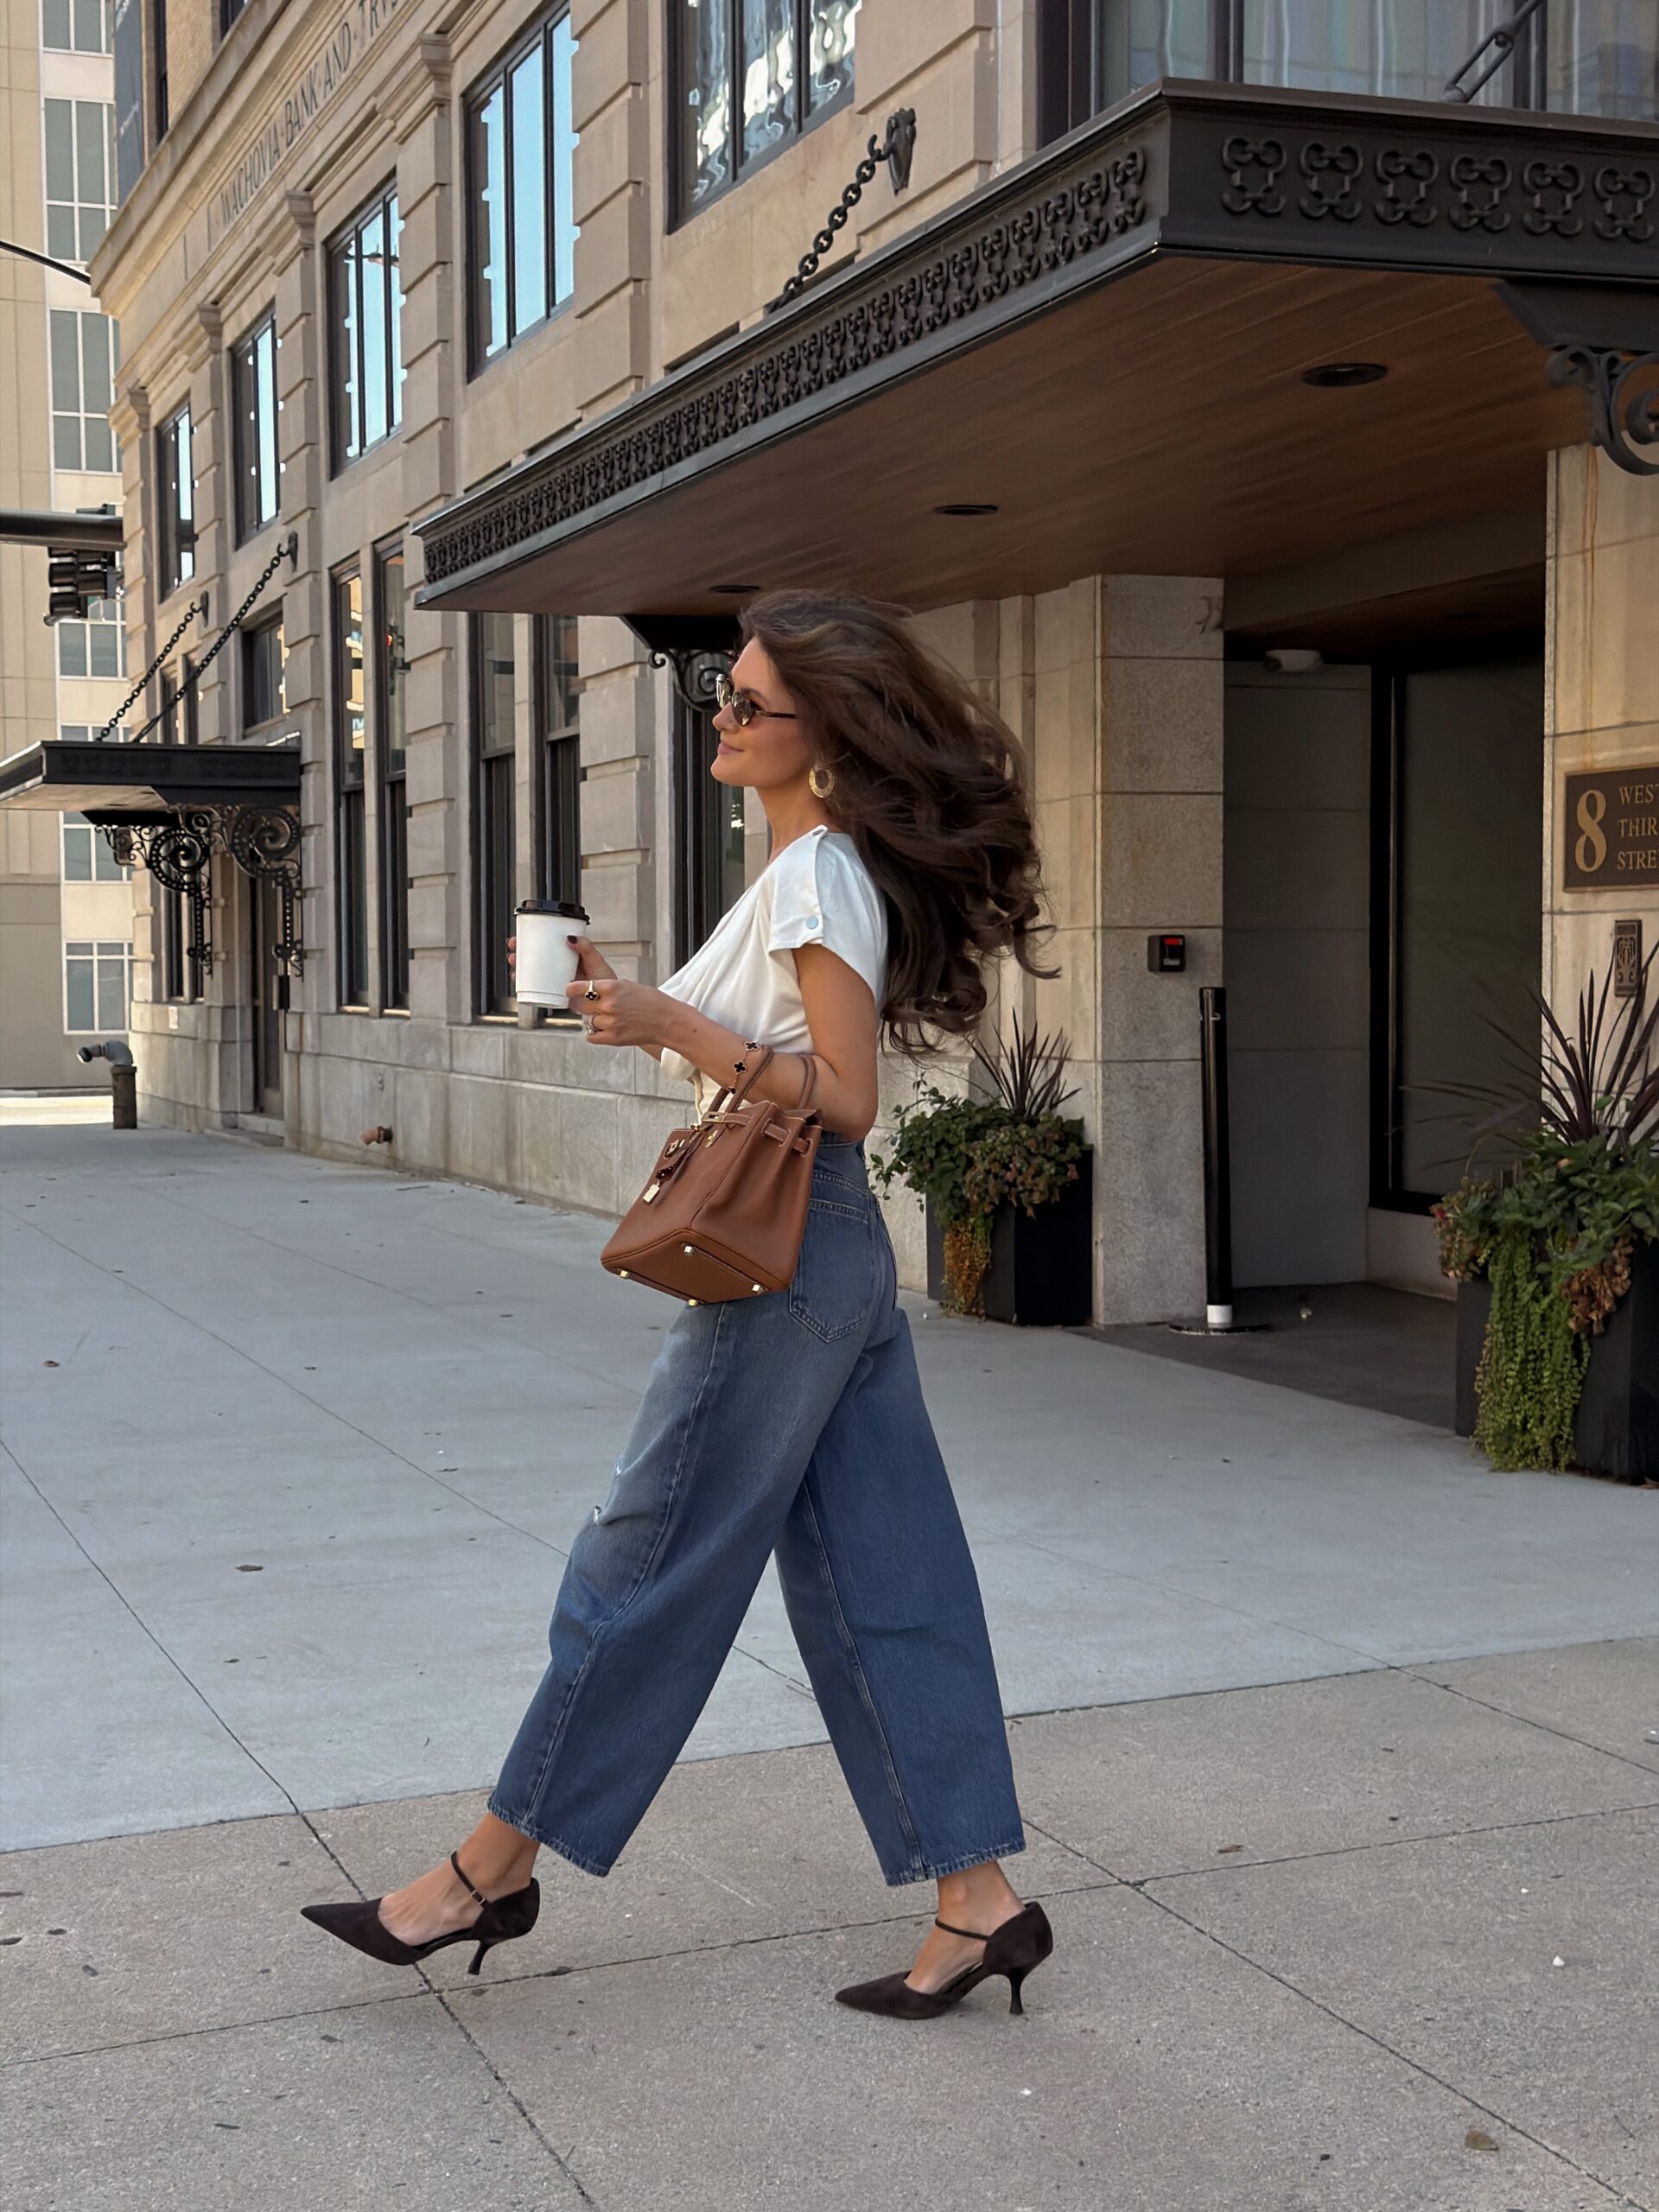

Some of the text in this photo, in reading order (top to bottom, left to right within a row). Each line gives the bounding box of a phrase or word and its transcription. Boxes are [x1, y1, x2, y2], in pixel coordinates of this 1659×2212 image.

[220, 121, 281, 226] WACHOVIA
[285, 60, 319, 149] BANK
[323, 22, 352, 99] AND
[1574, 789, 1607, 873] 8
[1617, 849, 1659, 870] STRE
